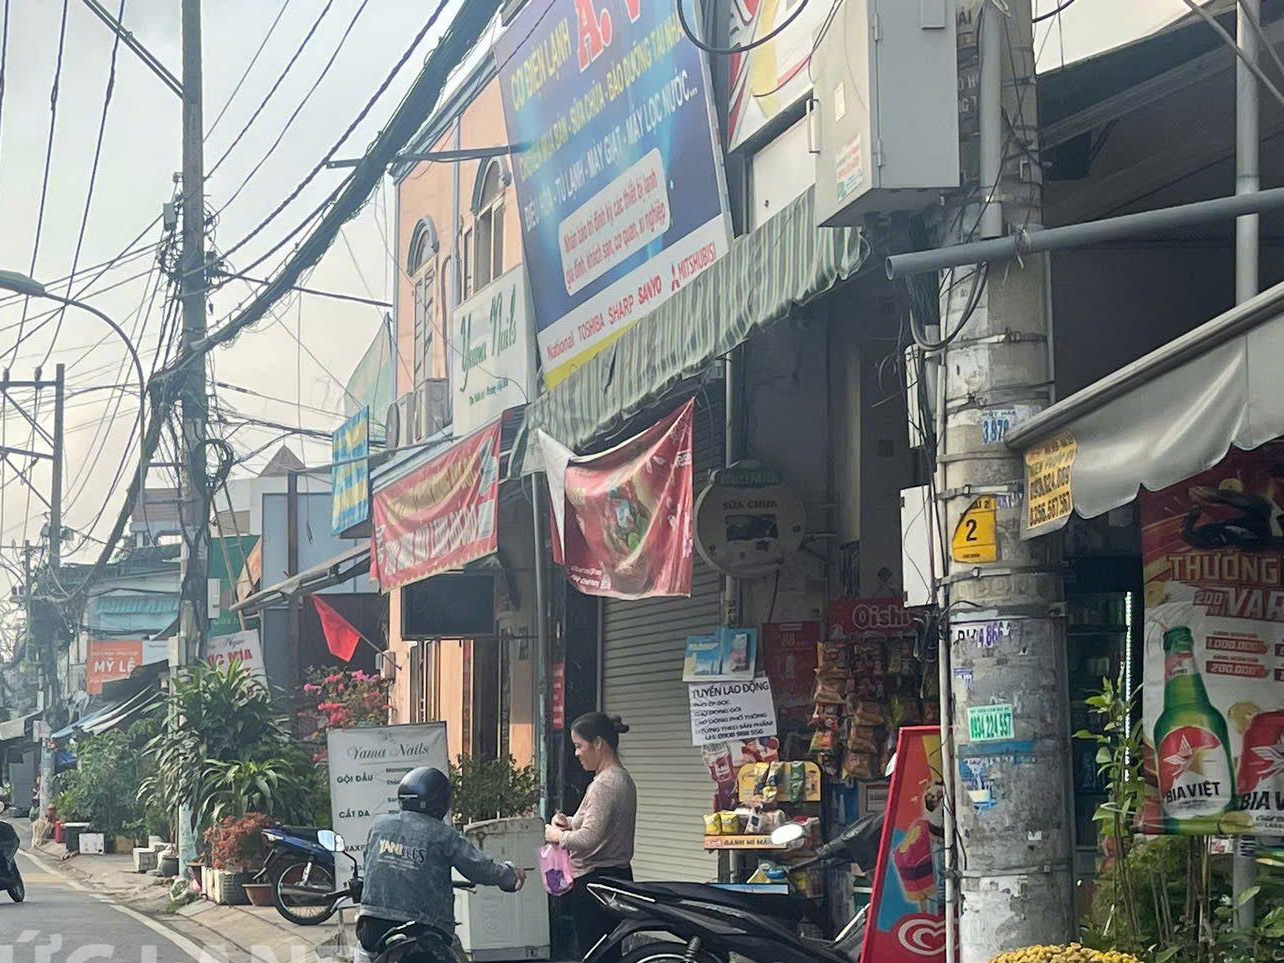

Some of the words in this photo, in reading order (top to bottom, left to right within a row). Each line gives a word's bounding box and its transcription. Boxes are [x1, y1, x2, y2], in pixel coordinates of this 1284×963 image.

[608, 294, 633, 325] SHARP
[638, 275, 662, 305] SANYO
[966, 519, 977, 541] 2
[723, 684, 741, 695] LAO
[742, 681, 769, 694] ĐỘNG
[347, 745, 386, 760] Yama
[1167, 786, 1185, 803] BIA
[1185, 780, 1220, 798] VIỆT
